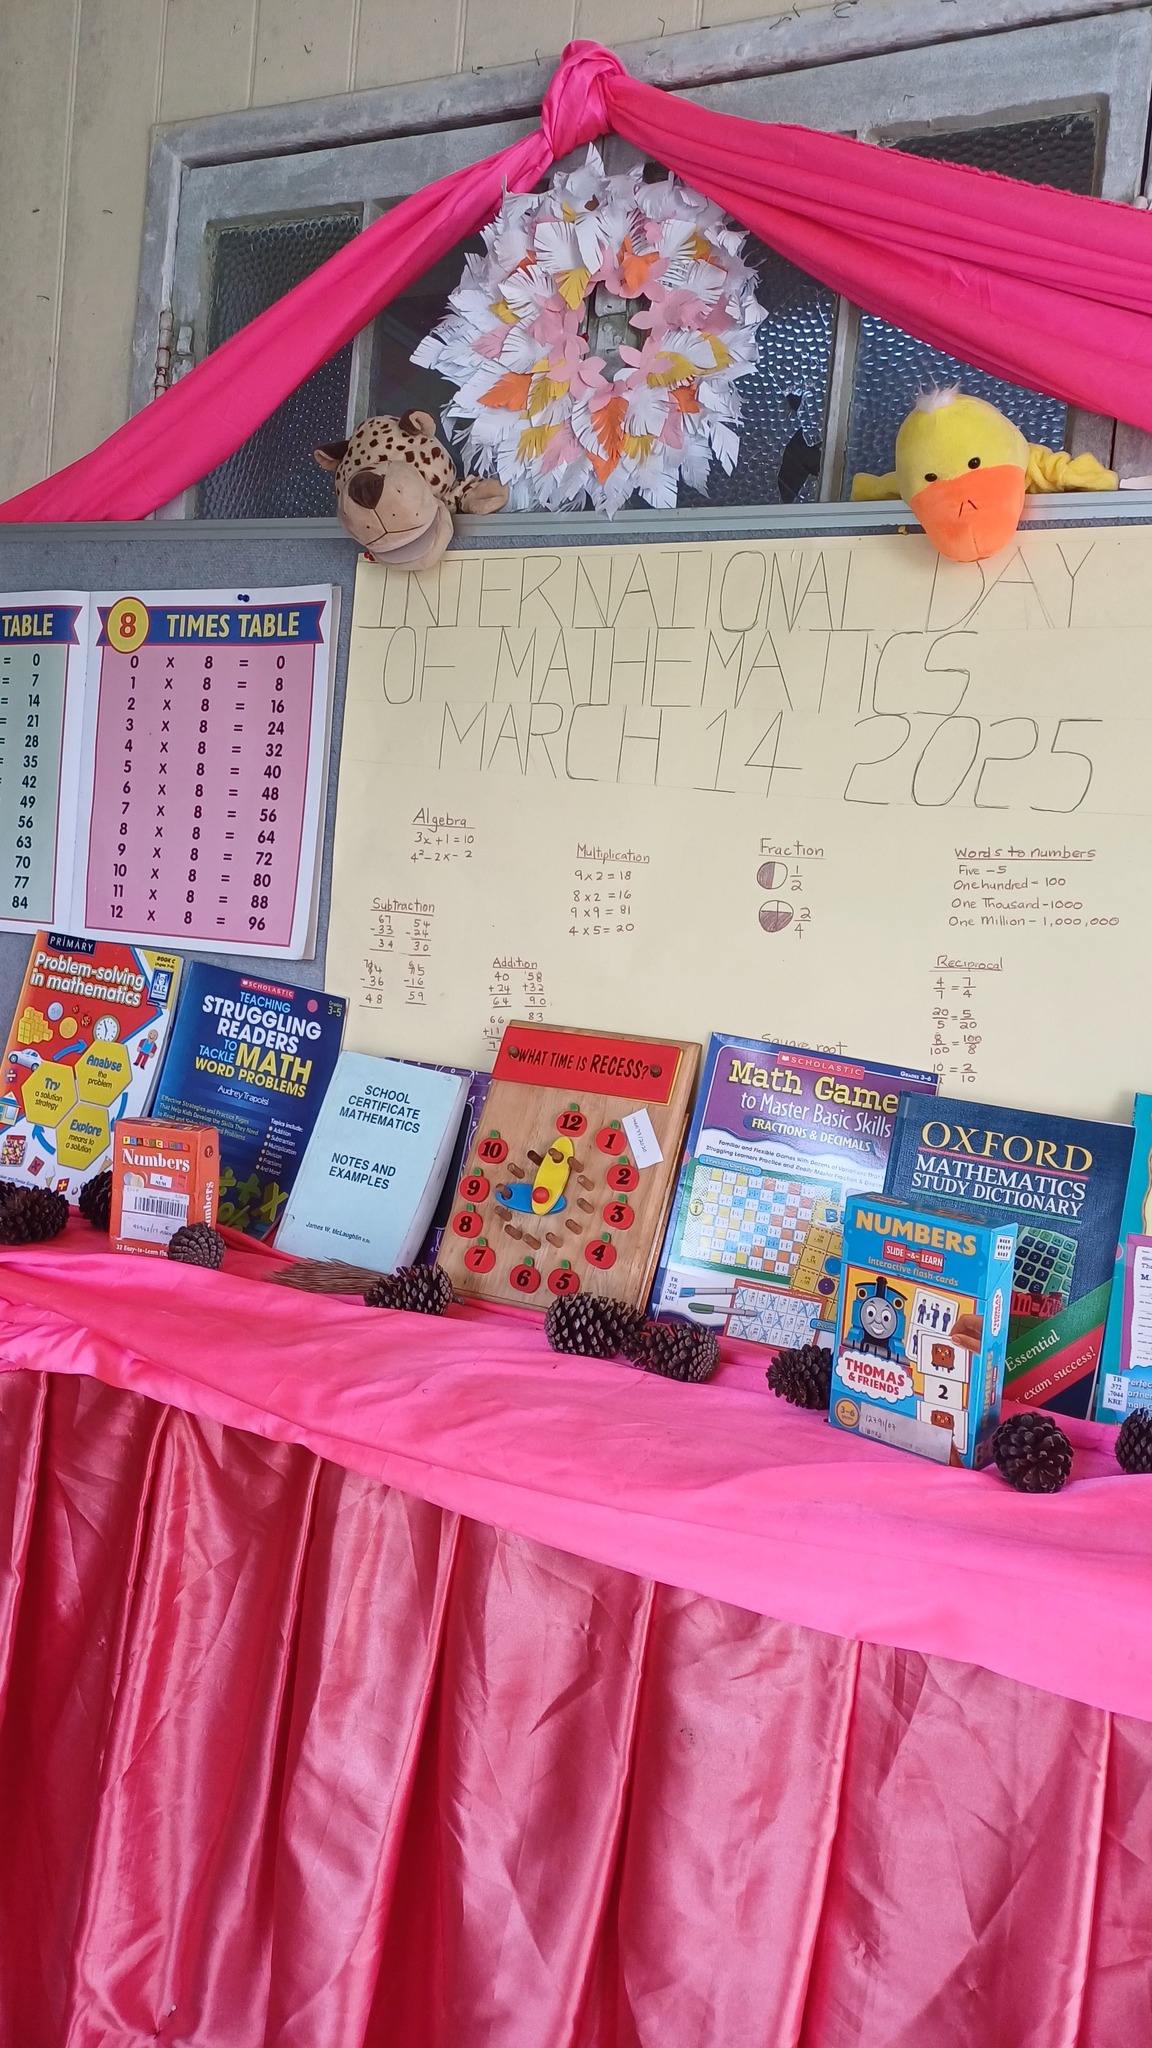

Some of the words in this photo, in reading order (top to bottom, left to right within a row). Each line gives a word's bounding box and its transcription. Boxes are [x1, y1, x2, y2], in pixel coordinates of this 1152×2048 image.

[357, 549, 875, 633] INTERNATIONAL
[925, 542, 1096, 633] DAY
[2, 613, 54, 638] TABLE
[118, 612, 137, 638] 8
[166, 613, 231, 638] TIMES
[238, 611, 300, 637] TABLE
[32, 654, 40, 667] 0
[276, 657, 285, 669] 0
[383, 626, 457, 705] OF
[492, 627, 978, 716] MATHEMATICS
[32, 674, 39, 687] 7
[275, 678, 283, 692] 8
[28, 694, 40, 707] 14
[270, 700, 285, 713] 16
[27, 714, 39, 727] 21
[267, 722, 285, 735] 24
[25, 735, 39, 748] 28
[265, 743, 283, 757] 32
[23, 755, 38, 768] 35
[438, 701, 662, 786] MARCH
[693, 709, 803, 798] 14
[843, 713, 1104, 813] 2025
[264, 765, 282, 779] 40
[22, 776, 37, 789] 42
[20, 796, 36, 809] 49
[261, 787, 279, 801] 48
[18, 816, 33, 829] 56
[259, 809, 277, 822] 56
[412, 807, 467, 833] Algebra
[16, 836, 32, 849] 63
[257, 830, 275, 844] 64
[577, 843, 650, 864] Multiplication
[759, 838, 825, 858] Fraction
[955, 847, 1003, 859] Words
[1008, 846, 1026, 859] to
[1030, 845, 1097, 859] numbers
[15, 856, 31, 869] 70
[255, 852, 273, 866] 72
[958, 865, 981, 876] Five
[14, 876, 29, 889] 77
[253, 874, 271, 887] 80
[1045, 877, 1067, 887] 100
[12, 896, 28, 909] 84
[251, 895, 268, 909] 88
[372, 897, 436, 913] Subtraction
[951, 898, 977, 910] One
[982, 897, 1040, 910] Thousand
[248, 917, 266, 931] 96
[948, 916, 976, 927] One
[981, 915, 1026, 927] Million
[50, 935, 94, 953] PRIMARY
[492, 956, 538, 969] Addition
[936, 954, 1004, 973] Reciprocal
[34, 951, 146, 992] Problem-solving
[30, 968, 44, 987] in
[46, 973, 142, 1007] mathematics
[248, 981, 294, 998] SCHOLASTIC
[240, 991, 291, 1014] TEACHING
[202, 994, 322, 1040] STRUGGLING
[327, 1006, 342, 1018] 3-5
[216, 1018, 300, 1055] READERS
[224, 1039, 238, 1052] TO
[816, 1041, 848, 1055] root
[86, 1054, 123, 1073] Analyse
[199, 1044, 236, 1064] TACKLE
[235, 1042, 313, 1085] MATH
[518, 1048, 549, 1066] WHAT
[550, 1052, 575, 1070] TIME
[576, 1055, 588, 1071] IS
[590, 1053, 649, 1080] RECESS?
[790, 1056, 862, 1076] SCHOLASTIC
[97, 1070, 108, 1079] the
[194, 1056, 235, 1078] WORD
[237, 1068, 307, 1099] PROBLEMS
[920, 1074, 933, 1083] 3-6
[44, 1077, 61, 1091] Try
[87, 1077, 113, 1090] problem
[217, 1084, 244, 1100] Audrey
[728, 1059, 803, 1096] Math
[814, 1076, 899, 1114] Game
[40, 1091, 63, 1103] solution
[364, 1085, 412, 1105] SCHOOL
[35, 1099, 59, 1112] strategy
[348, 1095, 421, 1121] CERTIFICATE
[339, 1106, 421, 1134] MATHEMATICS
[559, 1113, 583, 1132] 12
[740, 1091, 757, 1110] to
[759, 1093, 811, 1122] Master
[813, 1104, 852, 1131] Basic
[854, 1111, 892, 1139] Skills
[69, 1119, 103, 1137] Explore
[751, 1117, 807, 1139] FRACTIONS
[809, 1130, 817, 1141] &
[819, 1133, 872, 1152] DECIMALS
[68, 1133, 88, 1144] means
[88, 1137, 95, 1146] to
[604, 1133, 617, 1150] 1
[921, 1120, 1094, 1173] OXFORD
[70, 1142, 92, 1155] solution
[480, 1141, 502, 1158] 10
[121, 1148, 191, 1173] Numbers
[331, 1152, 370, 1173] NOTES
[370, 1162, 397, 1178] AND
[328, 1165, 390, 1191] EXAMPLES
[617, 1168, 633, 1186] 2
[914, 1154, 1087, 1201] MATHEMATICS
[466, 1179, 481, 1196] 9
[911, 1173, 971, 1197] STUDY
[972, 1182, 1084, 1218] DICTIONARY
[609, 1205, 626, 1223] 3
[305, 1221, 324, 1232] James
[458, 1215, 474, 1233] 8
[855, 1209, 977, 1256] NUMBERS
[472, 1249, 488, 1266] 7
[591, 1245, 606, 1262] 4
[886, 1244, 904, 1257] SLIDE
[921, 1253, 943, 1268] LEARN
[515, 1270, 532, 1288] 6
[868, 1255, 912, 1275] interactive
[912, 1266, 959, 1288] flash-cards
[555, 1272, 573, 1291] 5
[1004, 1328, 1061, 1373] Essential
[844, 1357, 906, 1387] THOMAS
[1023, 1378, 1053, 1402] exam
[1052, 1345, 1097, 1382] success!
[847, 1371, 857, 1382] &
[857, 1374, 900, 1397] FRIENDS
[937, 1384, 949, 1401] 2
[1111, 1382, 1122, 1391] 372
[840, 1406, 856, 1418] 3-6
